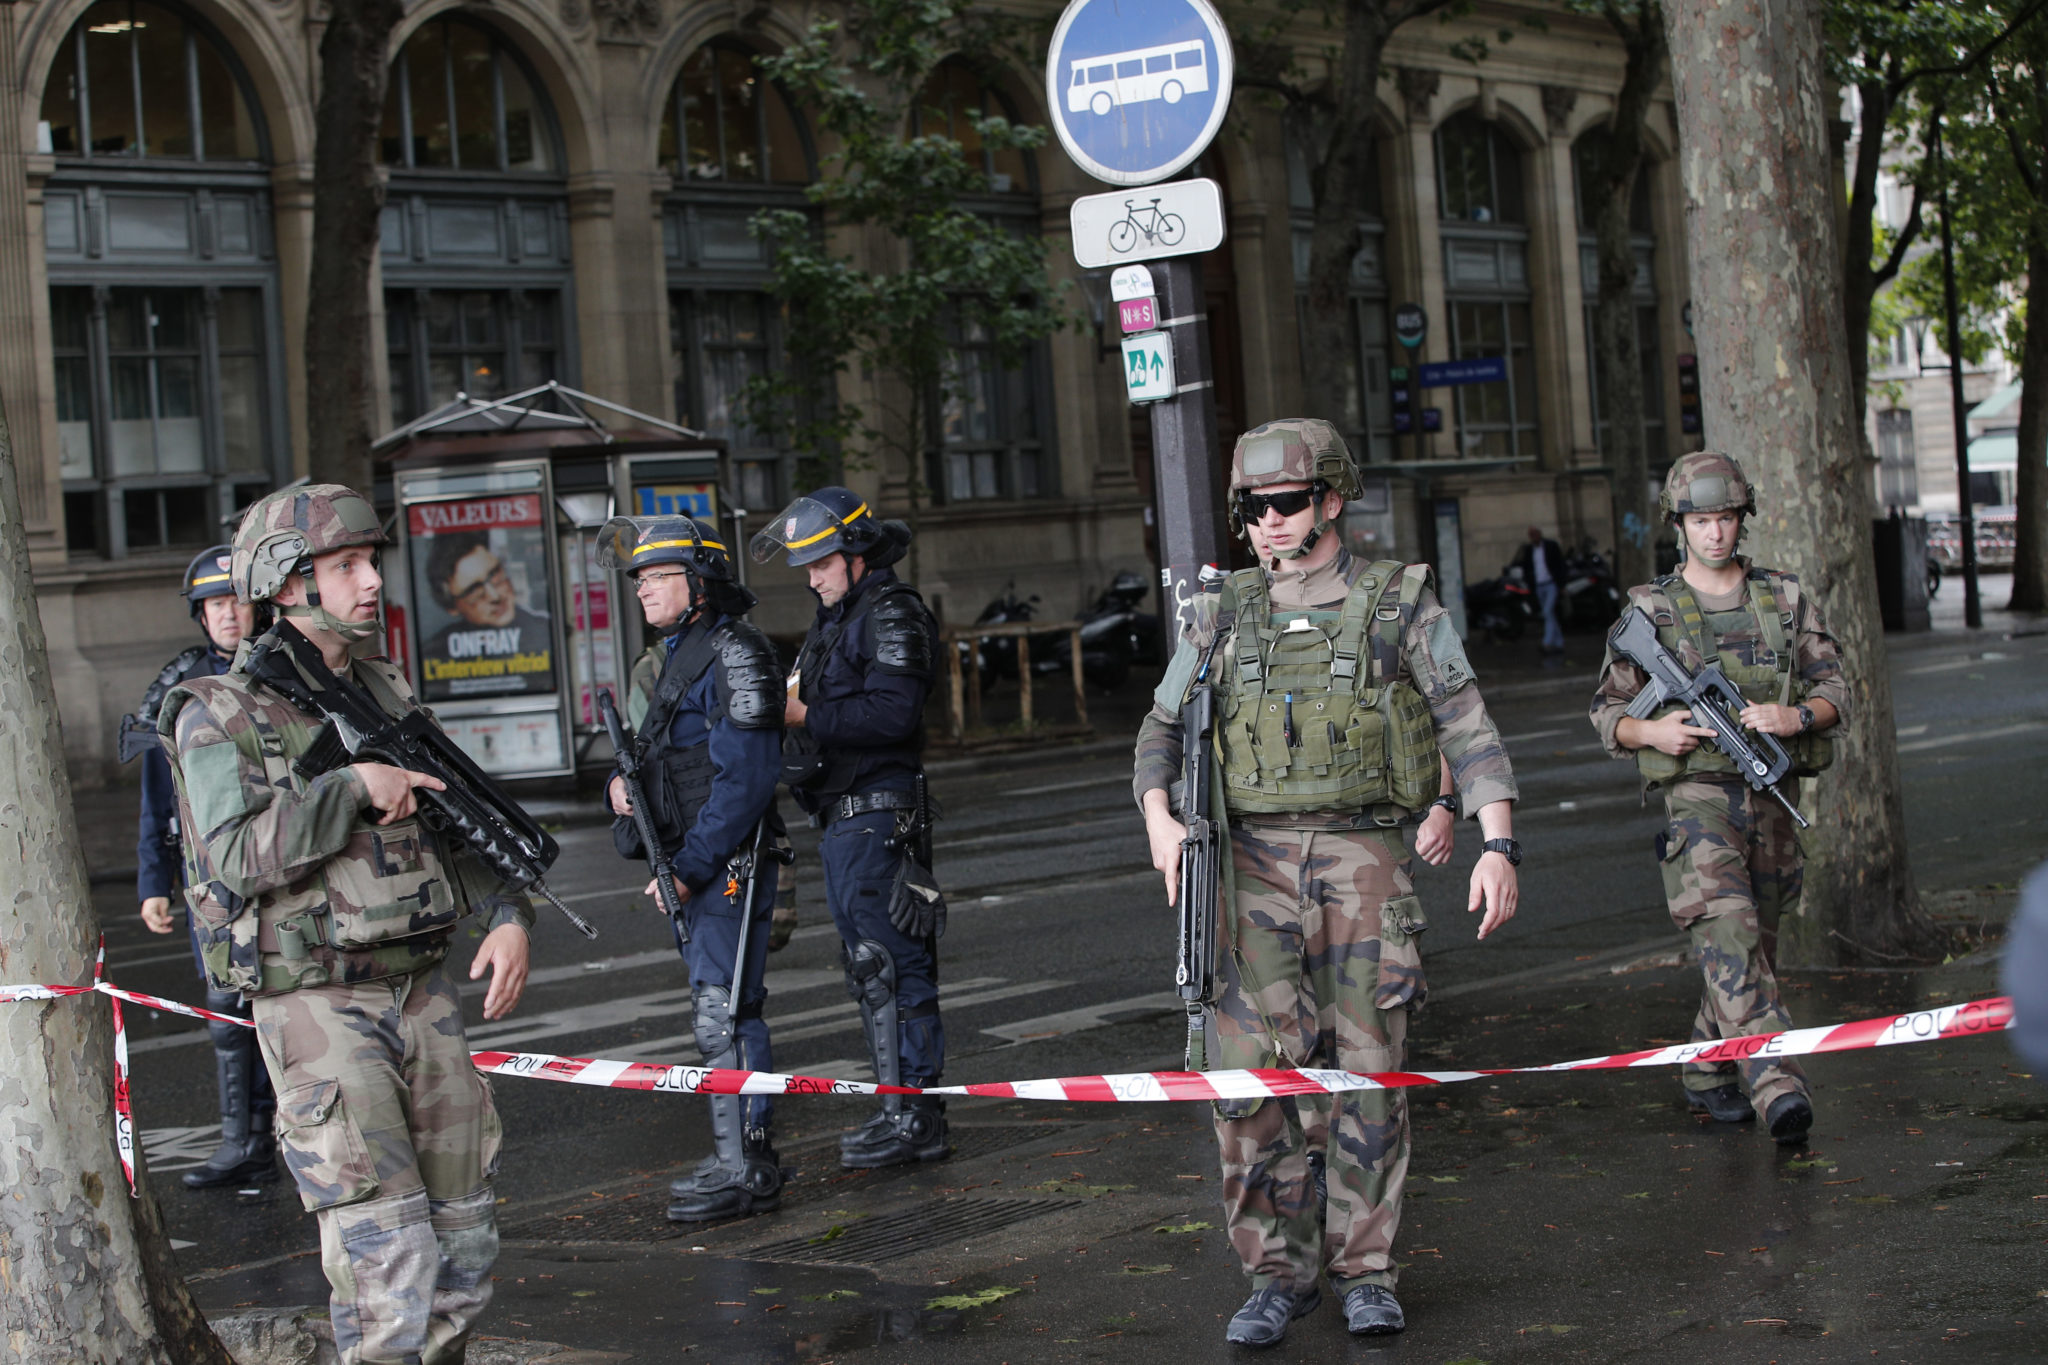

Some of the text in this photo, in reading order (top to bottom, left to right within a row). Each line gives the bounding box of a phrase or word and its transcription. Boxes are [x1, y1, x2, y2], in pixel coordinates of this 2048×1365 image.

[1396, 312, 1422, 329] BUS
[419, 499, 529, 527] VALEURS
[448, 628, 521, 658] ONFRAY
[424, 655, 505, 680] L'interview
[1447, 663, 1456, 673] A
[1892, 1001, 2010, 1039] POLICE
[1676, 1034, 1785, 1060] POLICE
[640, 1066, 713, 1092] POLICE
